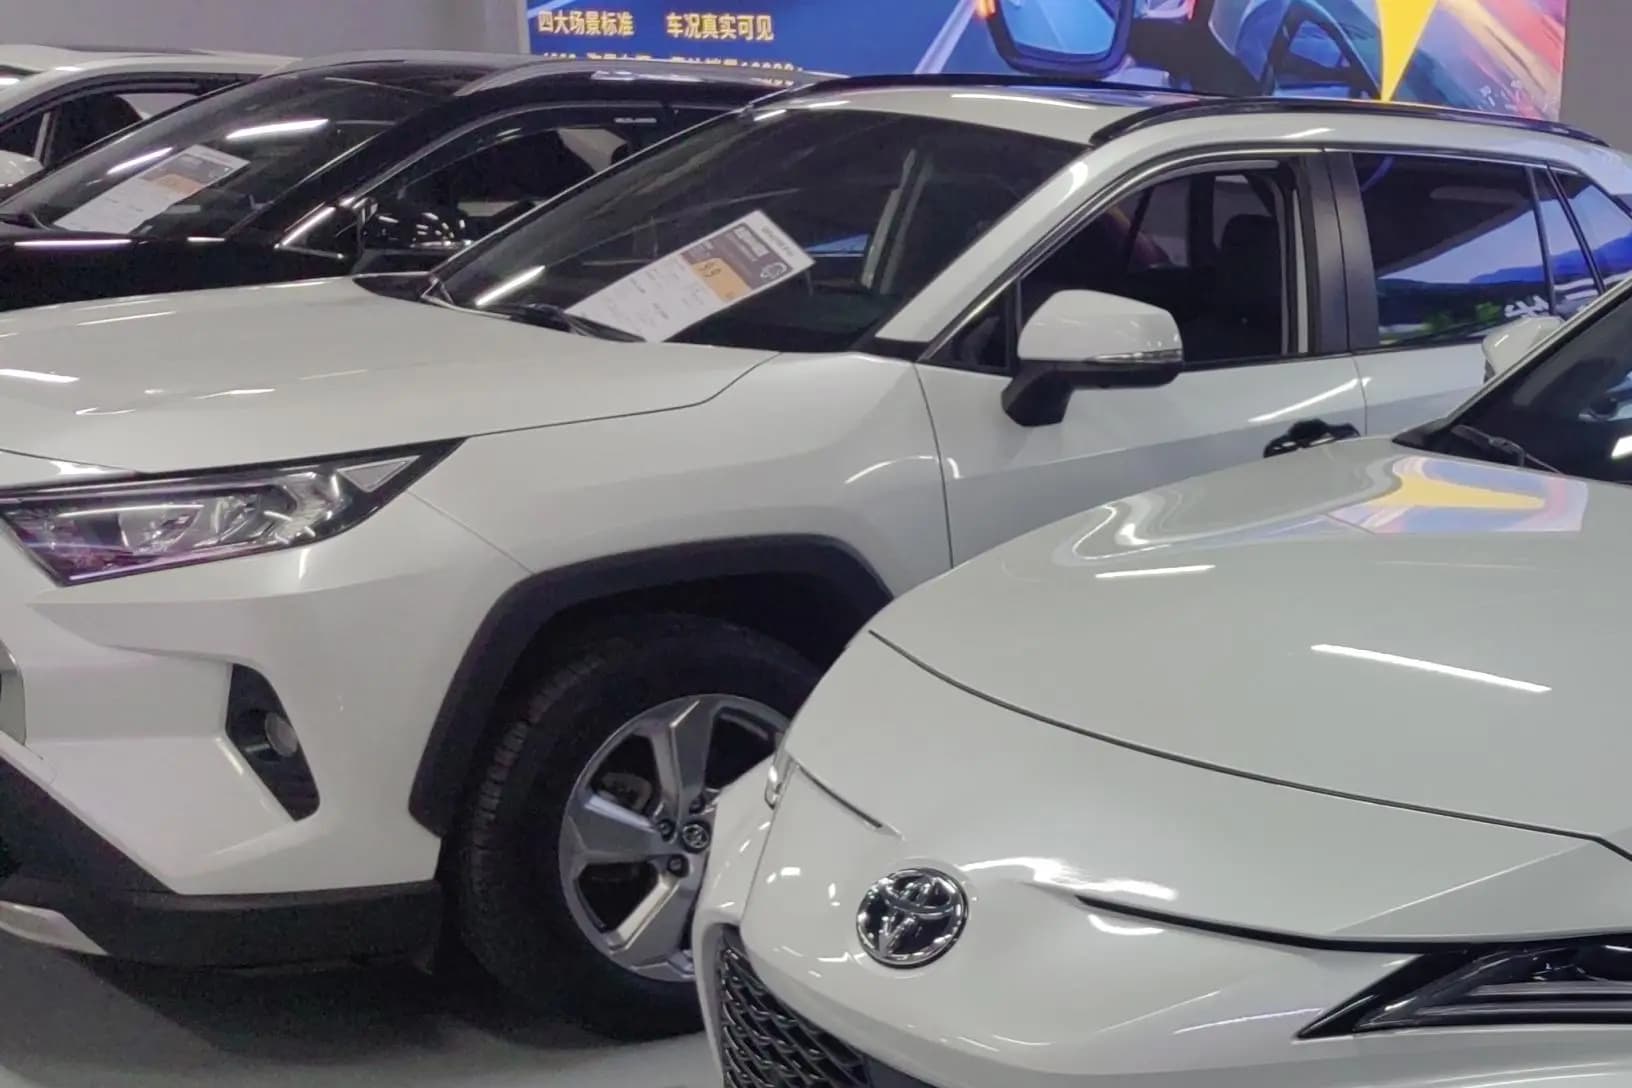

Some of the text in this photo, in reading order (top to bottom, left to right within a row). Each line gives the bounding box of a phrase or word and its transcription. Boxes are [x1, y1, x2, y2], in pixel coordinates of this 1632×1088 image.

[537, 10, 775, 41] 四大场景标准 车况真实可见
